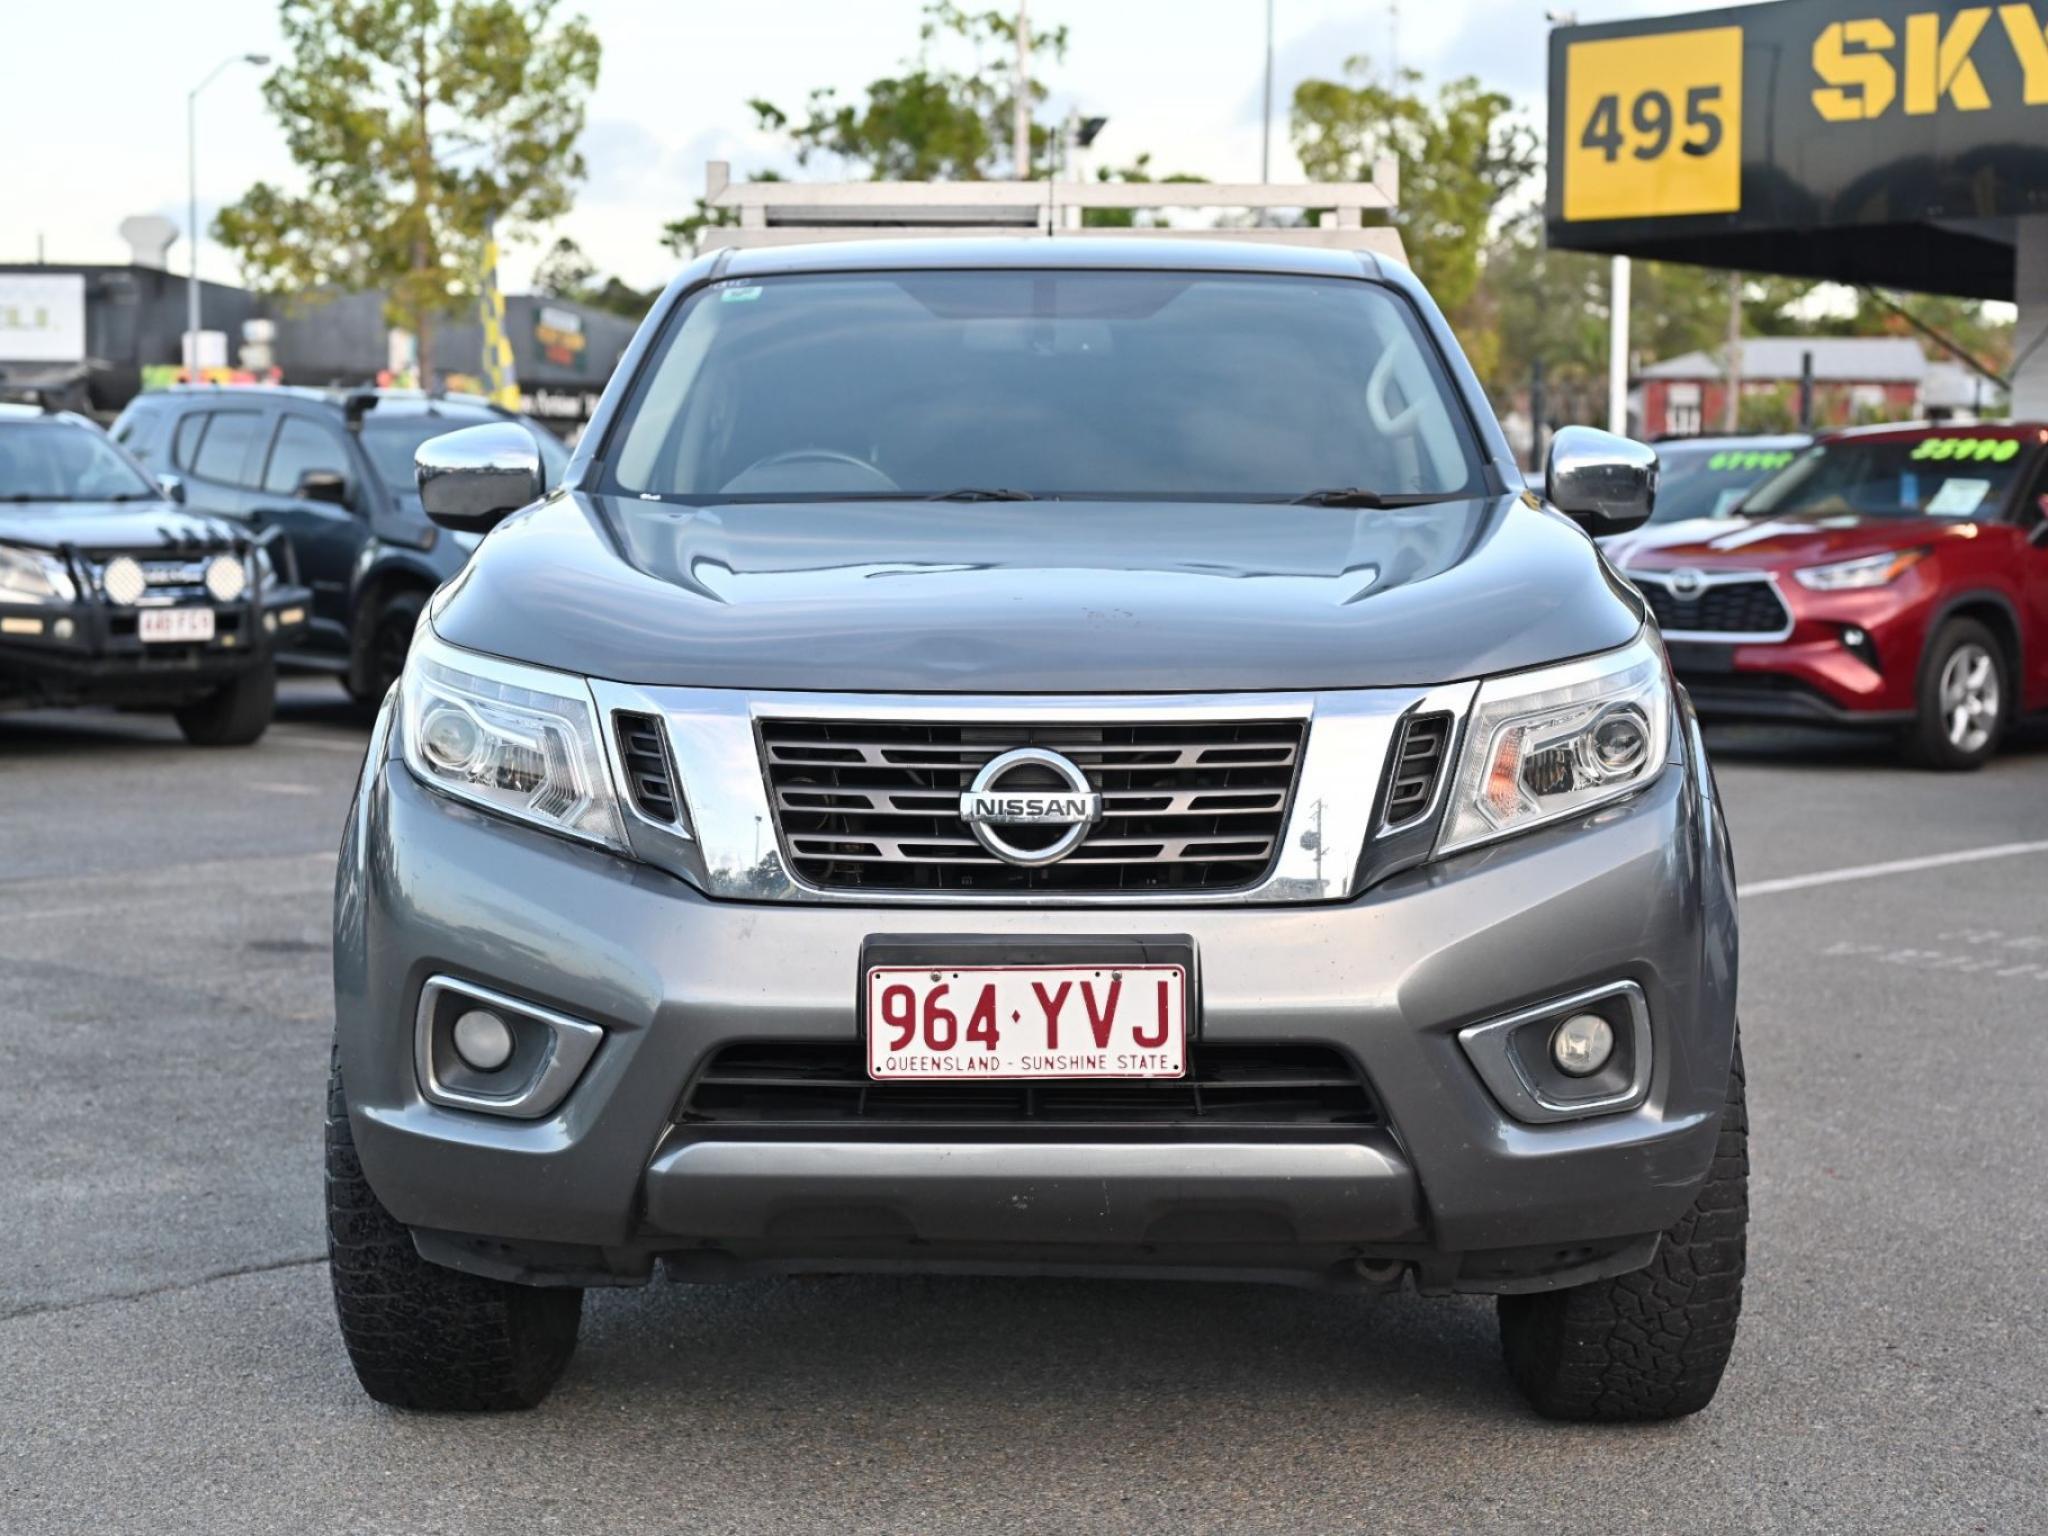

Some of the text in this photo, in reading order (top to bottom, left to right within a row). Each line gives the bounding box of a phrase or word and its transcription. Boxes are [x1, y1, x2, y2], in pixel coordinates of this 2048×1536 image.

[1811, 3, 2048, 121] SKY
[1581, 84, 1724, 163] 495
[976, 799, 1086, 816] NISSAN
[881, 981, 1169, 1051] 964 YVJ
[886, 1056, 1000, 1071] QUEENSLAND
[1021, 1055, 1107, 1070] SUNSHINE
[1117, 1054, 1169, 1069] STATE
